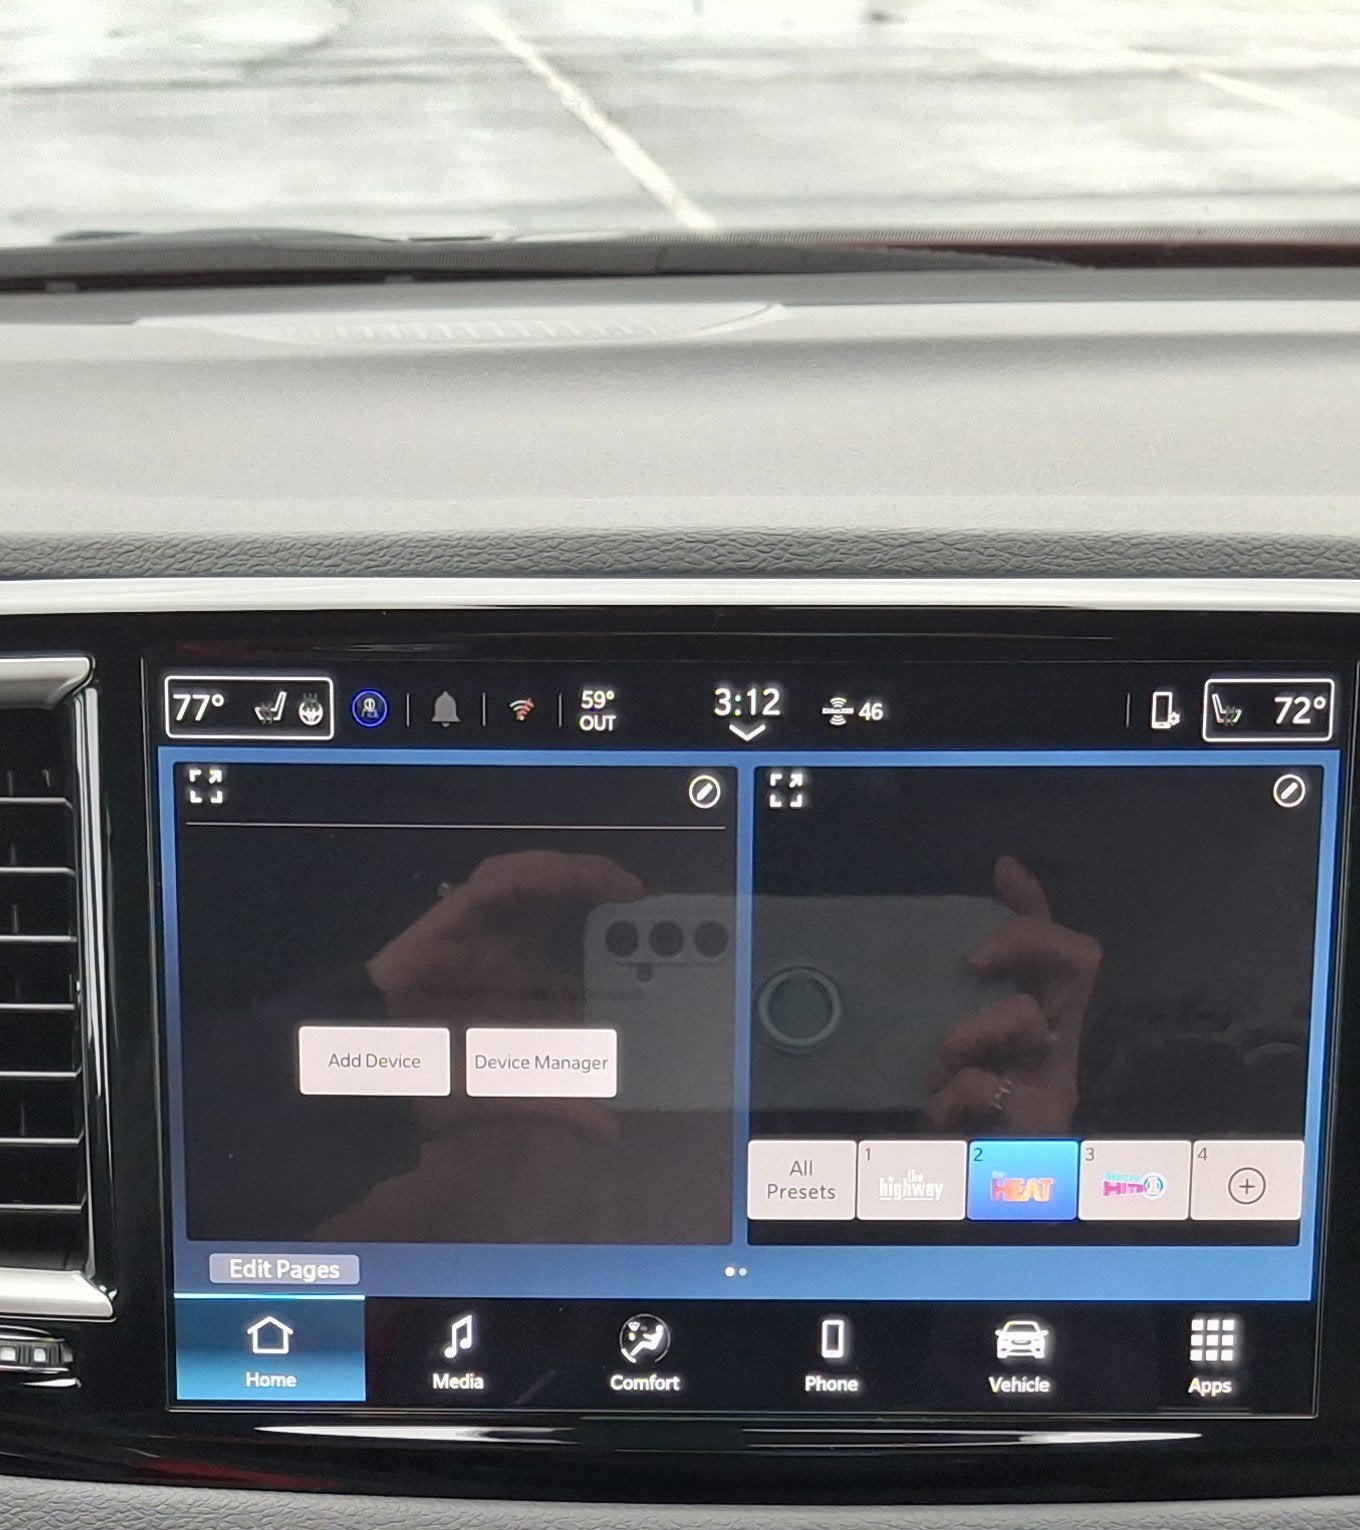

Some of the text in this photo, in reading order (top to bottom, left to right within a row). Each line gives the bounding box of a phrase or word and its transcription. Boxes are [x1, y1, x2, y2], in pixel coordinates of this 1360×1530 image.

[172, 692, 225, 722] 77°
[580, 689, 615, 709] 59°
[714, 687, 781, 716] 3:12
[858, 702, 883, 721] 46
[1273, 695, 1327, 726] 72°
[578, 714, 616, 732] OUT
[328, 1052, 421, 1070] Add Device
[474, 1053, 609, 1074] Device Manager
[865, 1147, 872, 1161] 1
[973, 1148, 984, 1162] 2
[1086, 1148, 1095, 1161] 3
[1197, 1148, 1208, 1161] 4
[789, 1159, 814, 1177] All
[766, 1182, 836, 1200] Presets
[879, 1177, 944, 1201] highway
[991, 1177, 1054, 1202] HEAT
[228, 1259, 341, 1283] Edit Pages
[245, 1372, 297, 1389] Home
[432, 1373, 484, 1391] Media
[610, 1373, 680, 1392] Comfort
[804, 1375, 859, 1393] Phone
[989, 1375, 1050, 1394] Vehicle
[1189, 1376, 1232, 1397] Apps
